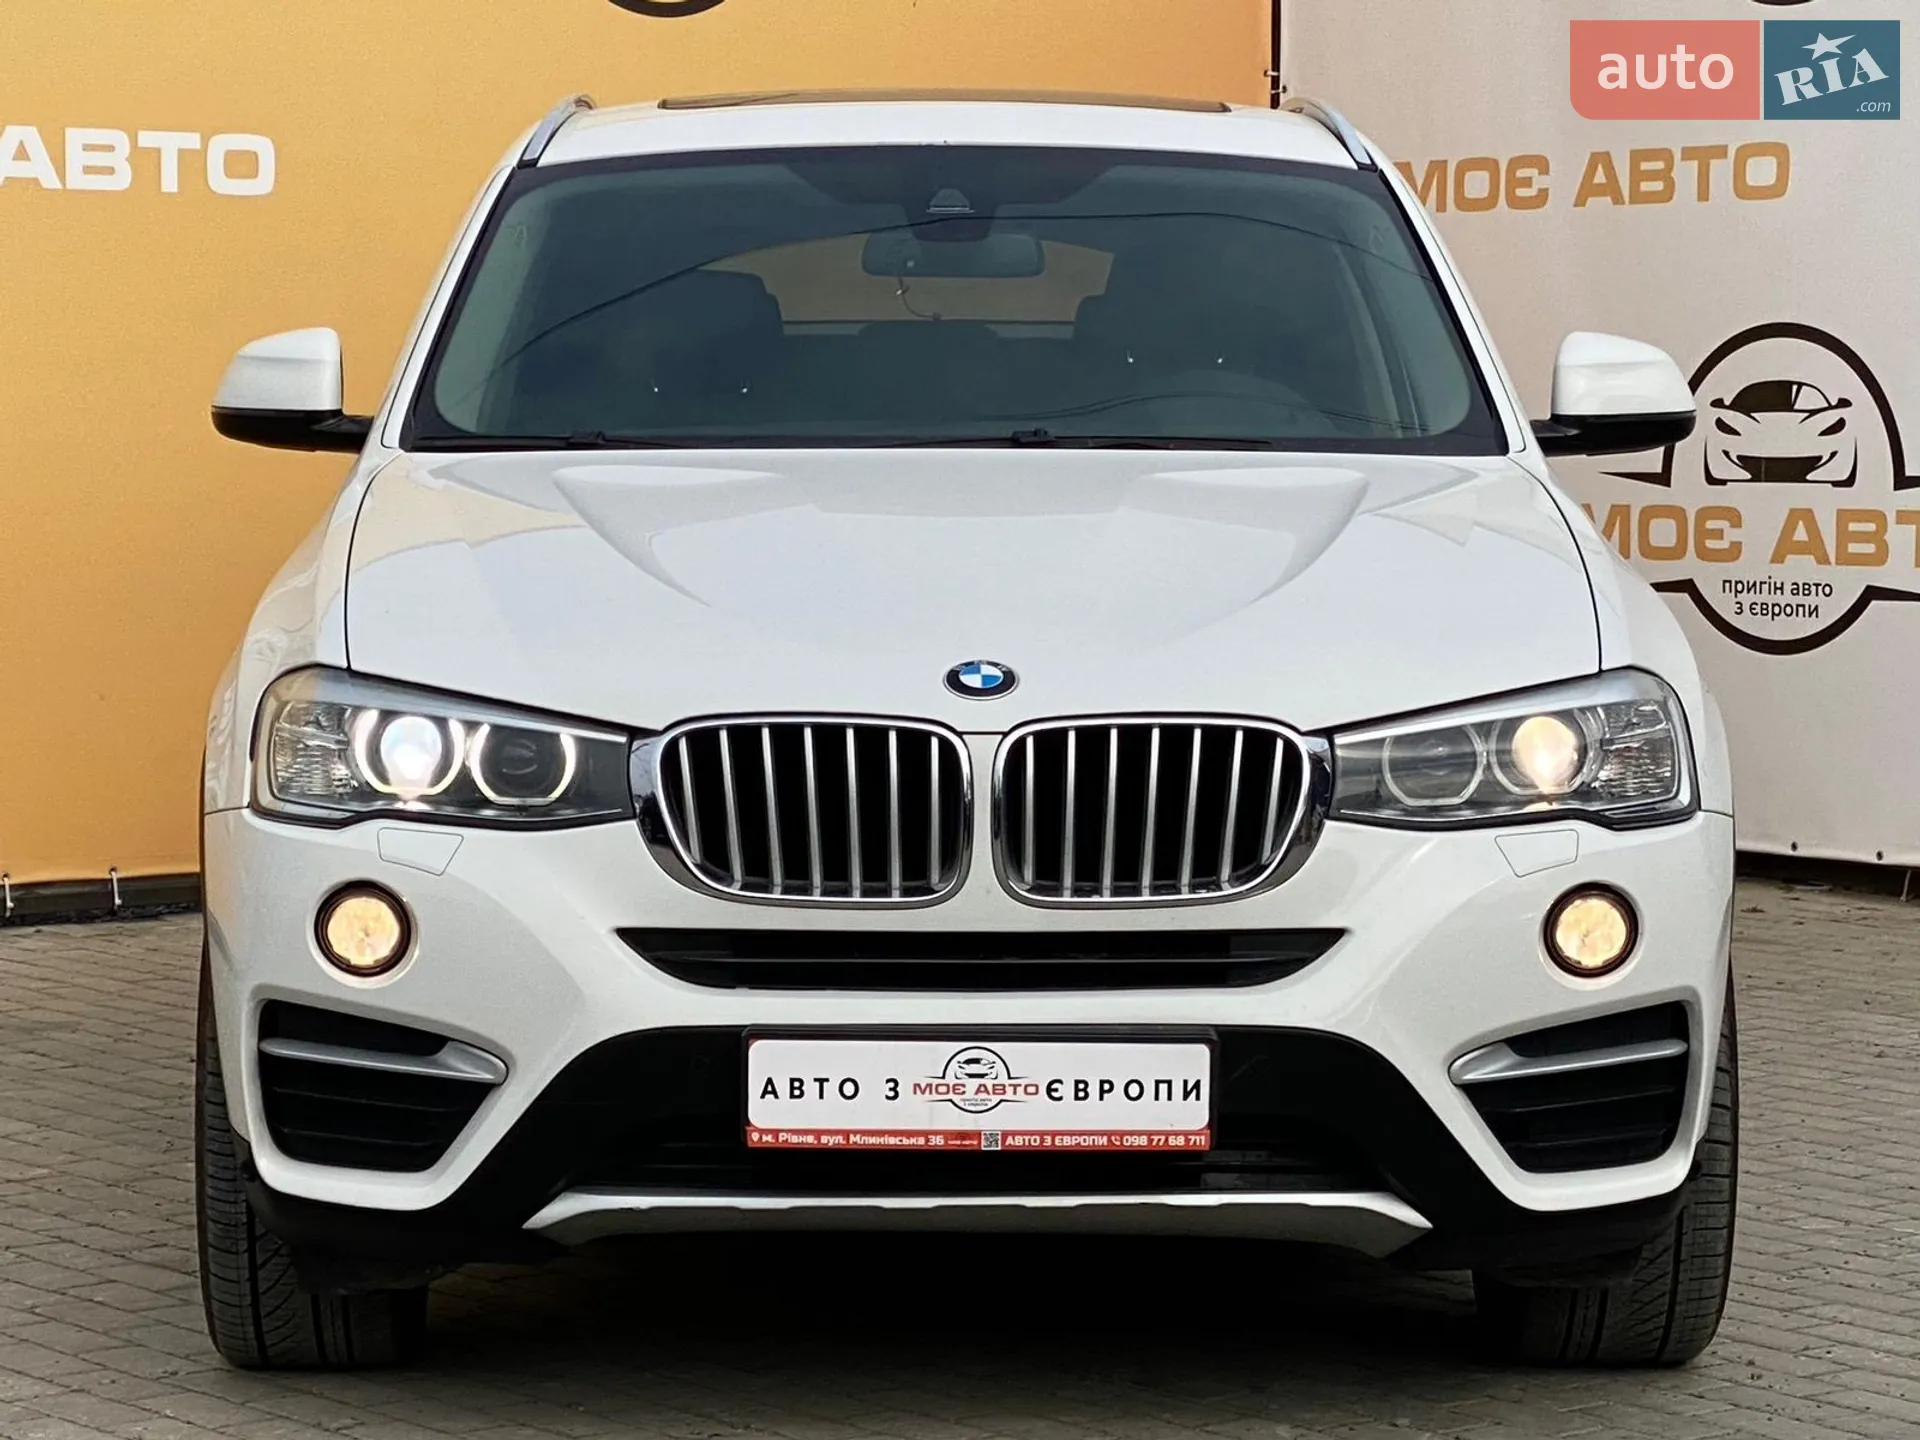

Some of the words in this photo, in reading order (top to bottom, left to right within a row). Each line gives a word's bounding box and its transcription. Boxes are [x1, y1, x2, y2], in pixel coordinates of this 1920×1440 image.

[0, 124, 276, 196] АВТО
[1574, 141, 1791, 208] АВТО
[1721, 575, 1785, 599] пригін
[1789, 581, 1834, 598] авто
[1748, 601, 1820, 622] європи
[759, 1076, 860, 1101] АВТО
[912, 1082, 967, 1096] МОЄ
[973, 1082, 1040, 1096] АВТО
[1045, 1078, 1202, 1102] ЄВРОПИ
[820, 1134, 846, 1146] вул.
[849, 1134, 926, 1146] Млинівська
[1005, 1135, 1041, 1147] АВТО
[1122, 1135, 1148, 1146] 098
[1150, 1135, 1166, 1146] 77
[1187, 1135, 1206, 1146] 711
